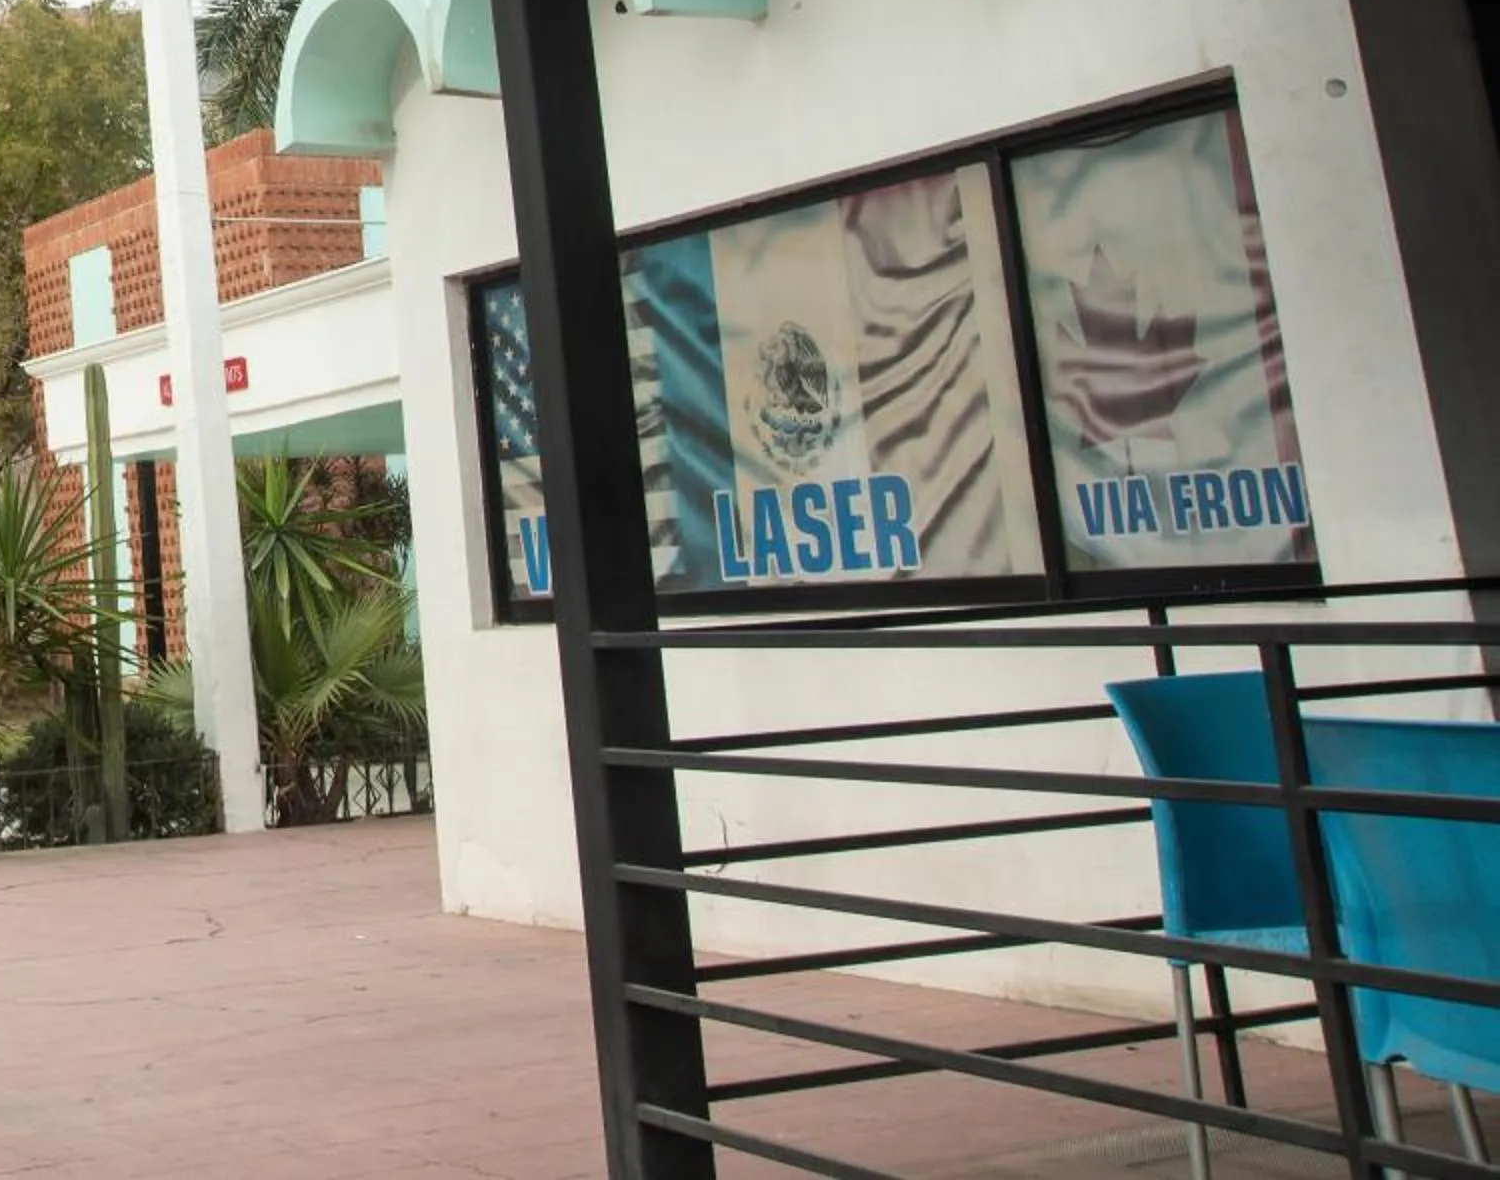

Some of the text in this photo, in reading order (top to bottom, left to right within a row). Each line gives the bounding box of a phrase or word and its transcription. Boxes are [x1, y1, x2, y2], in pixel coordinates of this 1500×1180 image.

[715, 475, 920, 578] LASER
[1076, 478, 1159, 536] VIA
[1169, 465, 1307, 531] FRON
